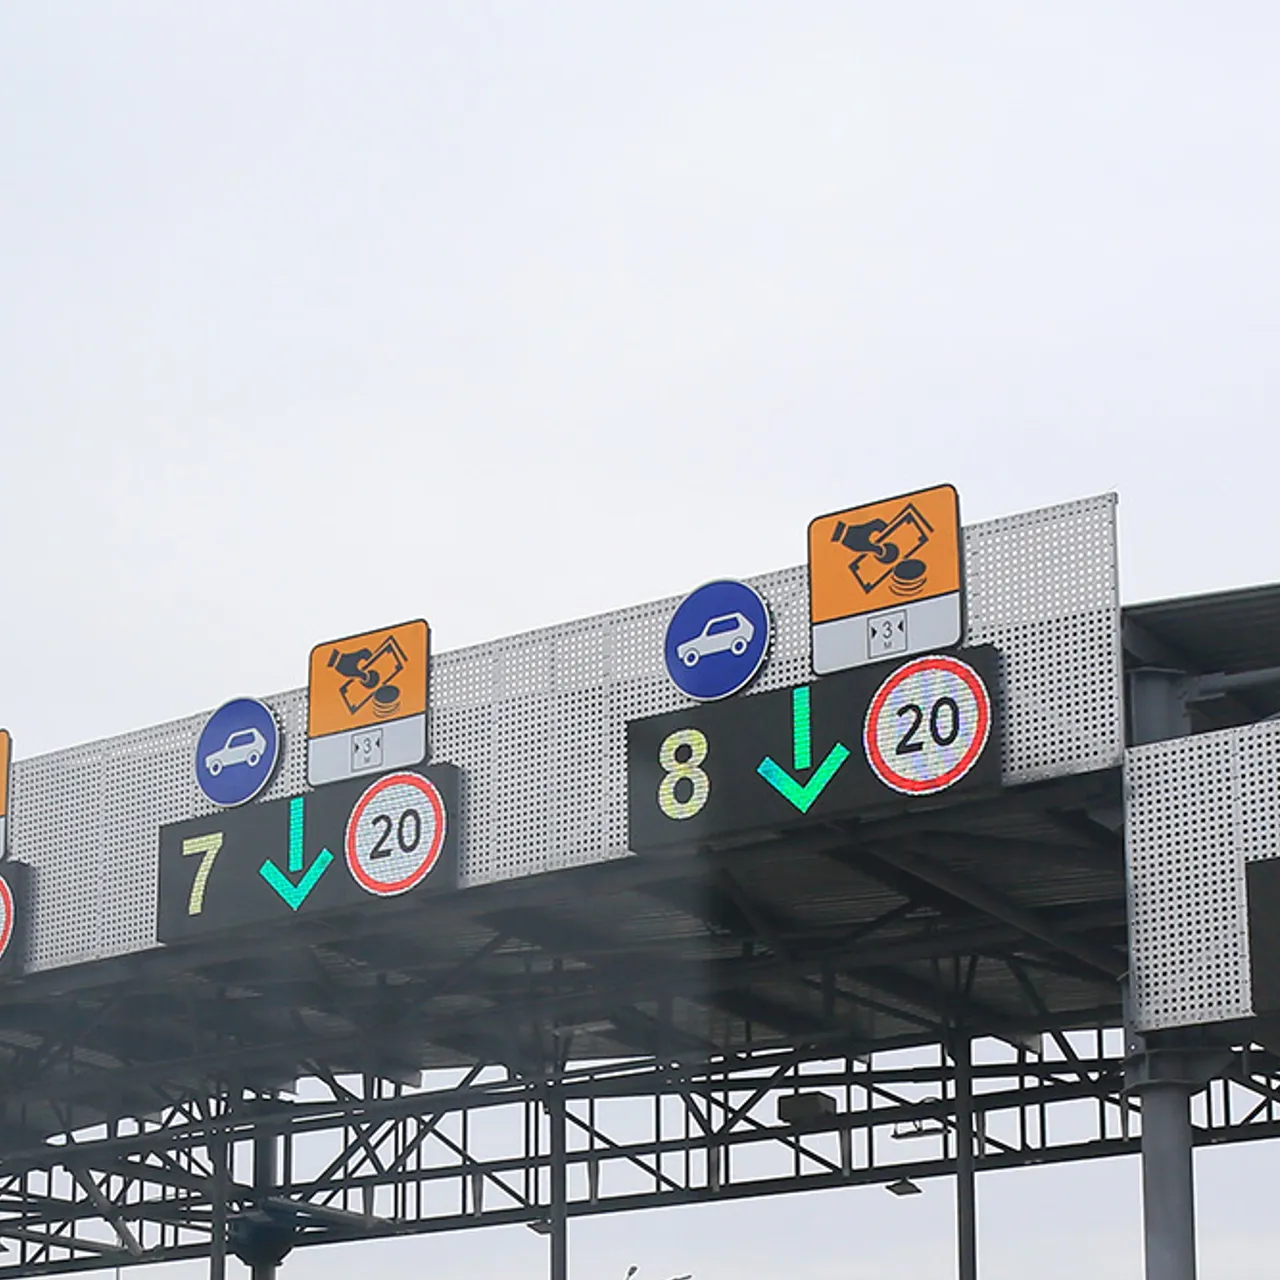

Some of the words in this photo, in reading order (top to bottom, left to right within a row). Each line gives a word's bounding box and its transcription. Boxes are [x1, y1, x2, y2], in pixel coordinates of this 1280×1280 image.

[882, 620, 893, 639] 3
[894, 697, 960, 755] 20
[657, 728, 711, 820] 8
[370, 808, 422, 860] 20
[182, 832, 224, 915] 7
